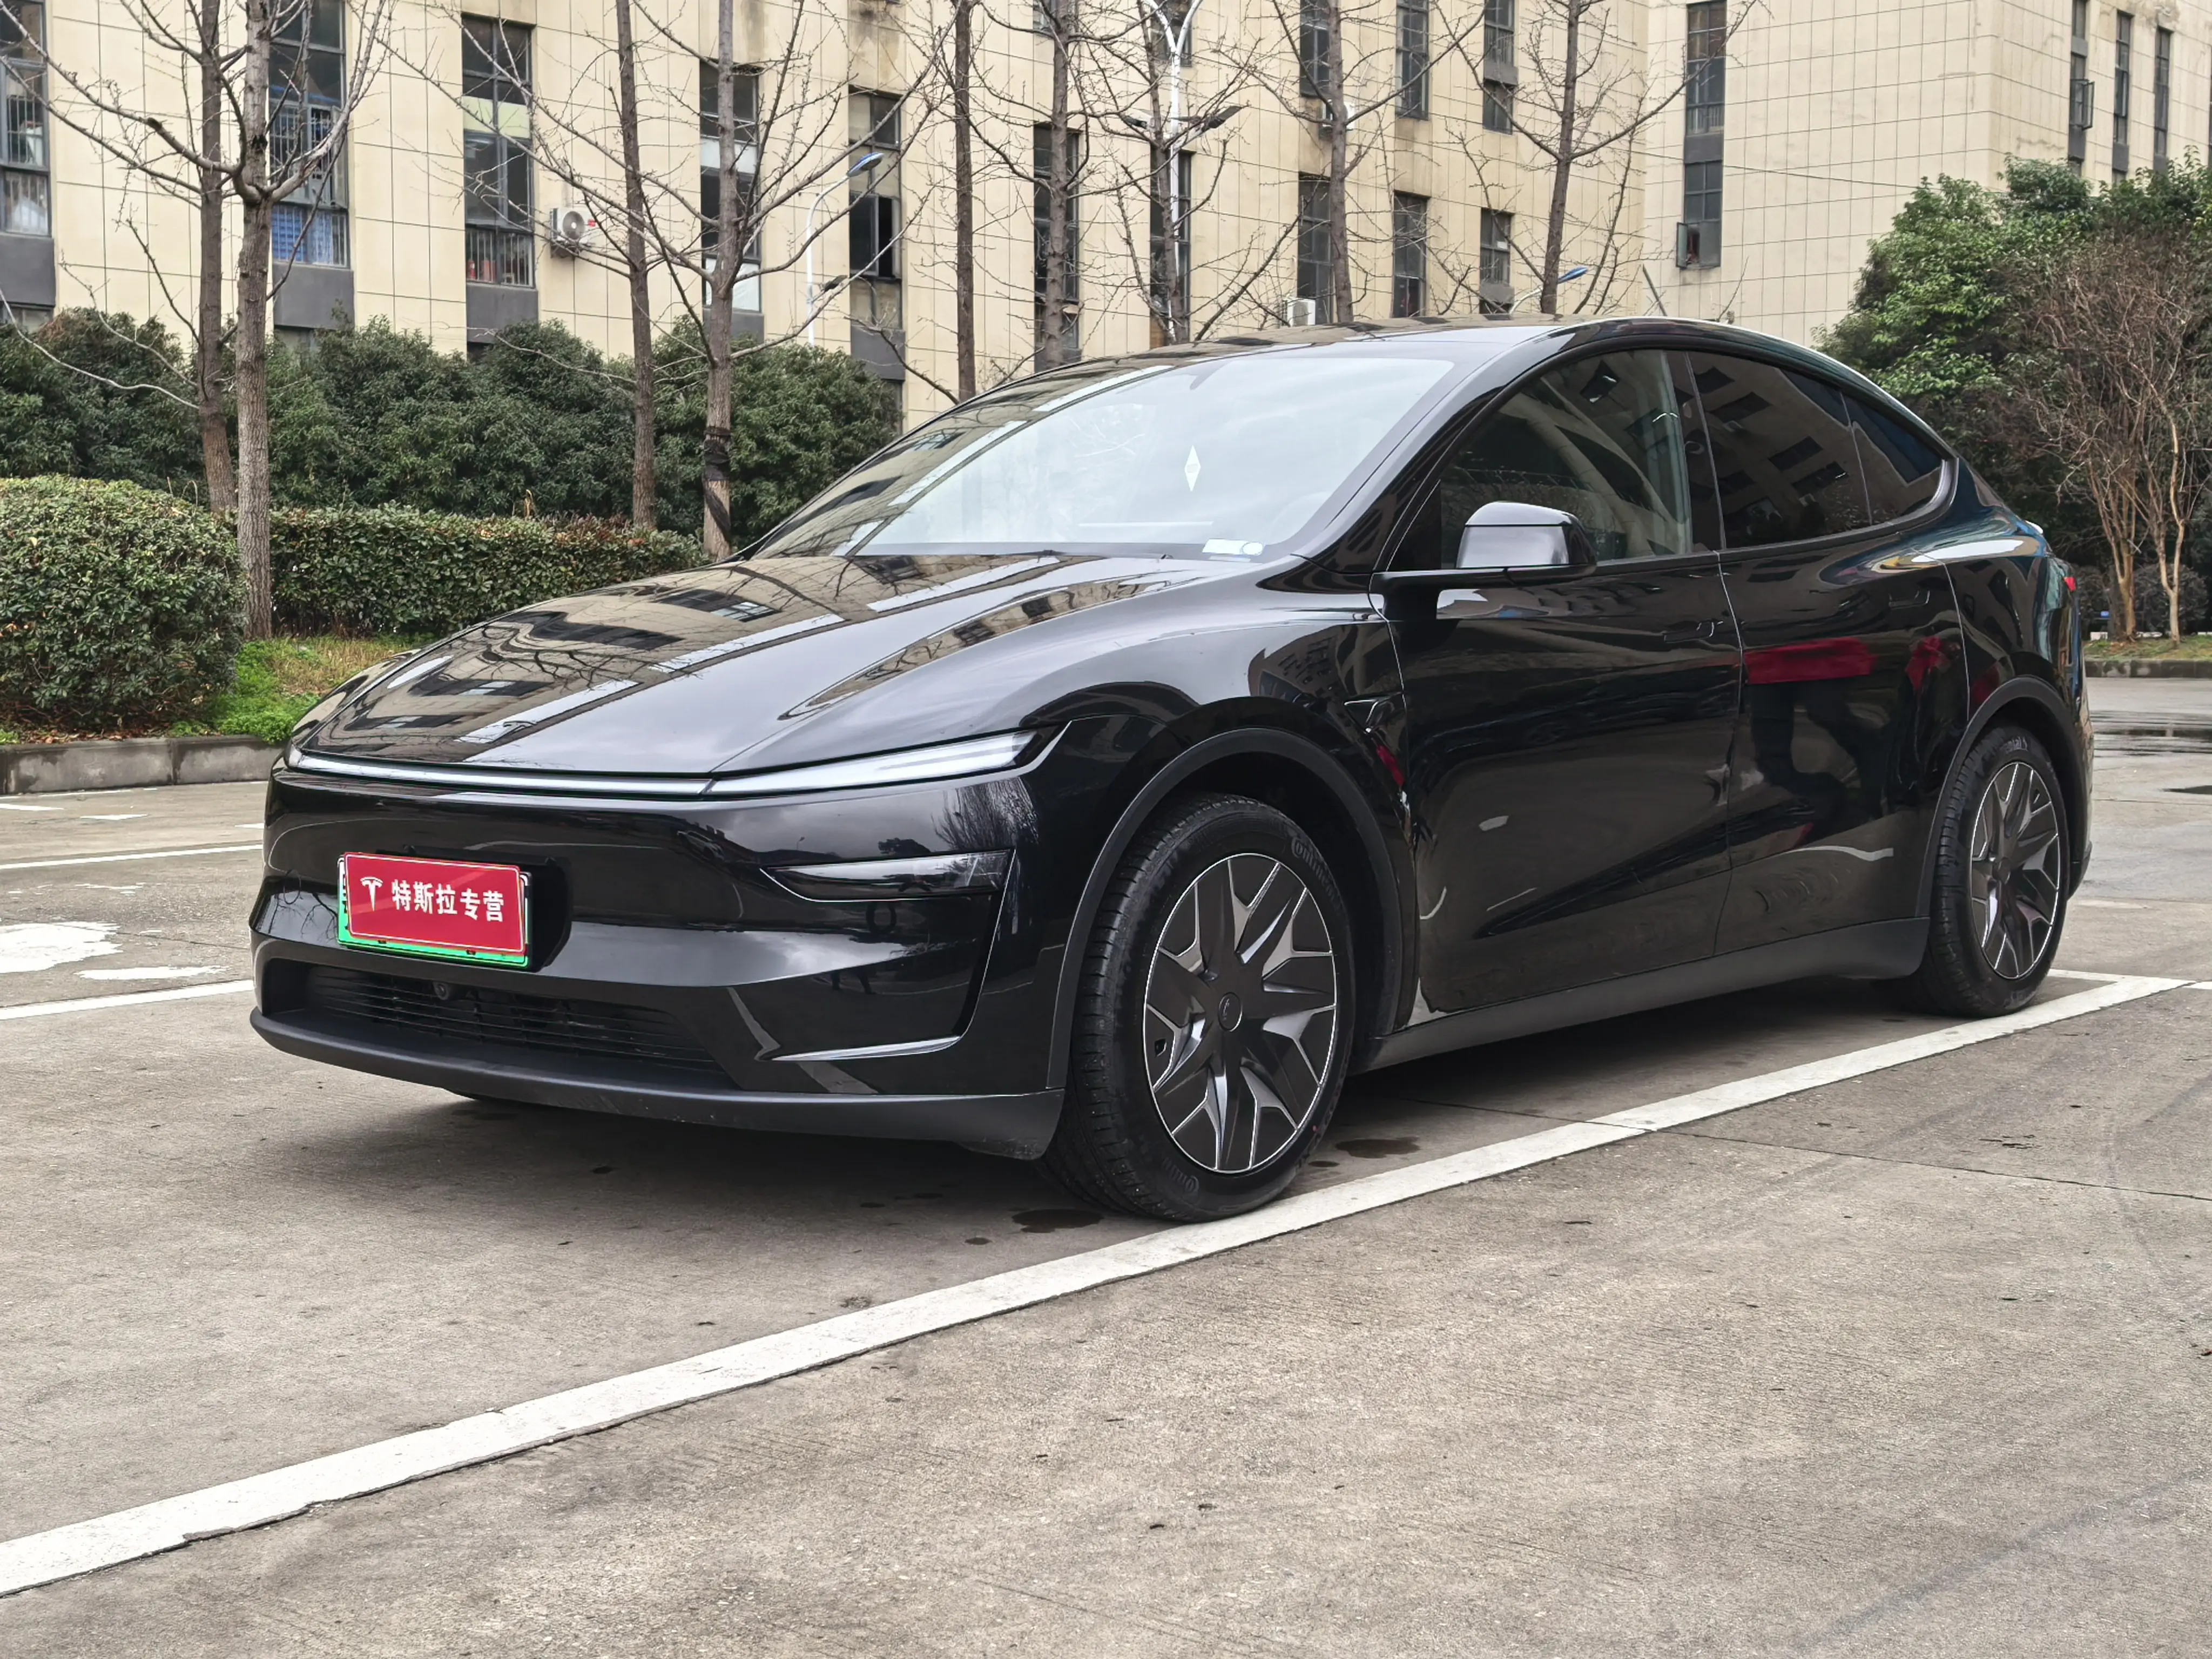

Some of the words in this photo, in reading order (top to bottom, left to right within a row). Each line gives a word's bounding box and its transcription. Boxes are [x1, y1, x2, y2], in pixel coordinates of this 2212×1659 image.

[392, 879, 503, 921] 特斯拉专营
